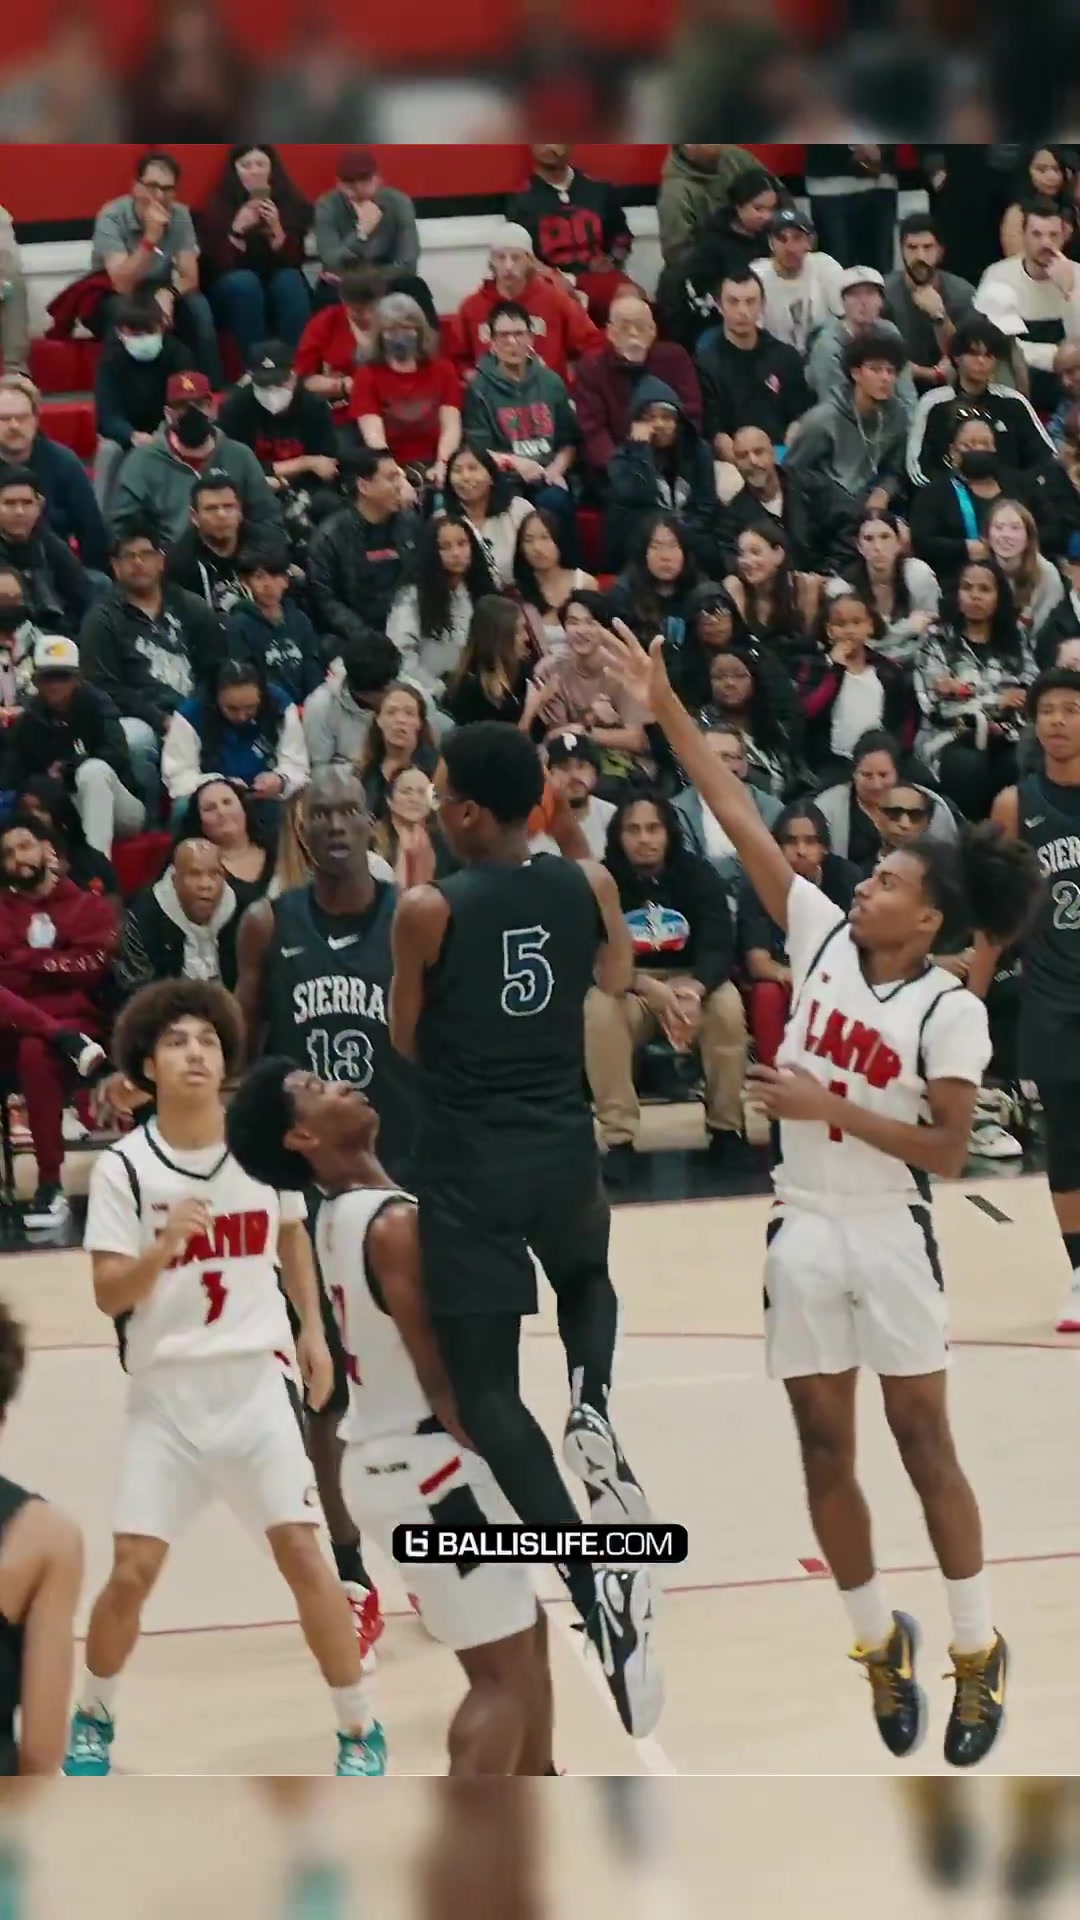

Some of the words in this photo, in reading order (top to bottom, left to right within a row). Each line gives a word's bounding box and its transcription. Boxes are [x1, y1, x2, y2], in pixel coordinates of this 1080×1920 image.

[293, 975, 389, 1026] SIERRA
[501, 924, 556, 1017] 5
[306, 1028, 375, 1089] 13
[166, 1209, 269, 1270] AND
